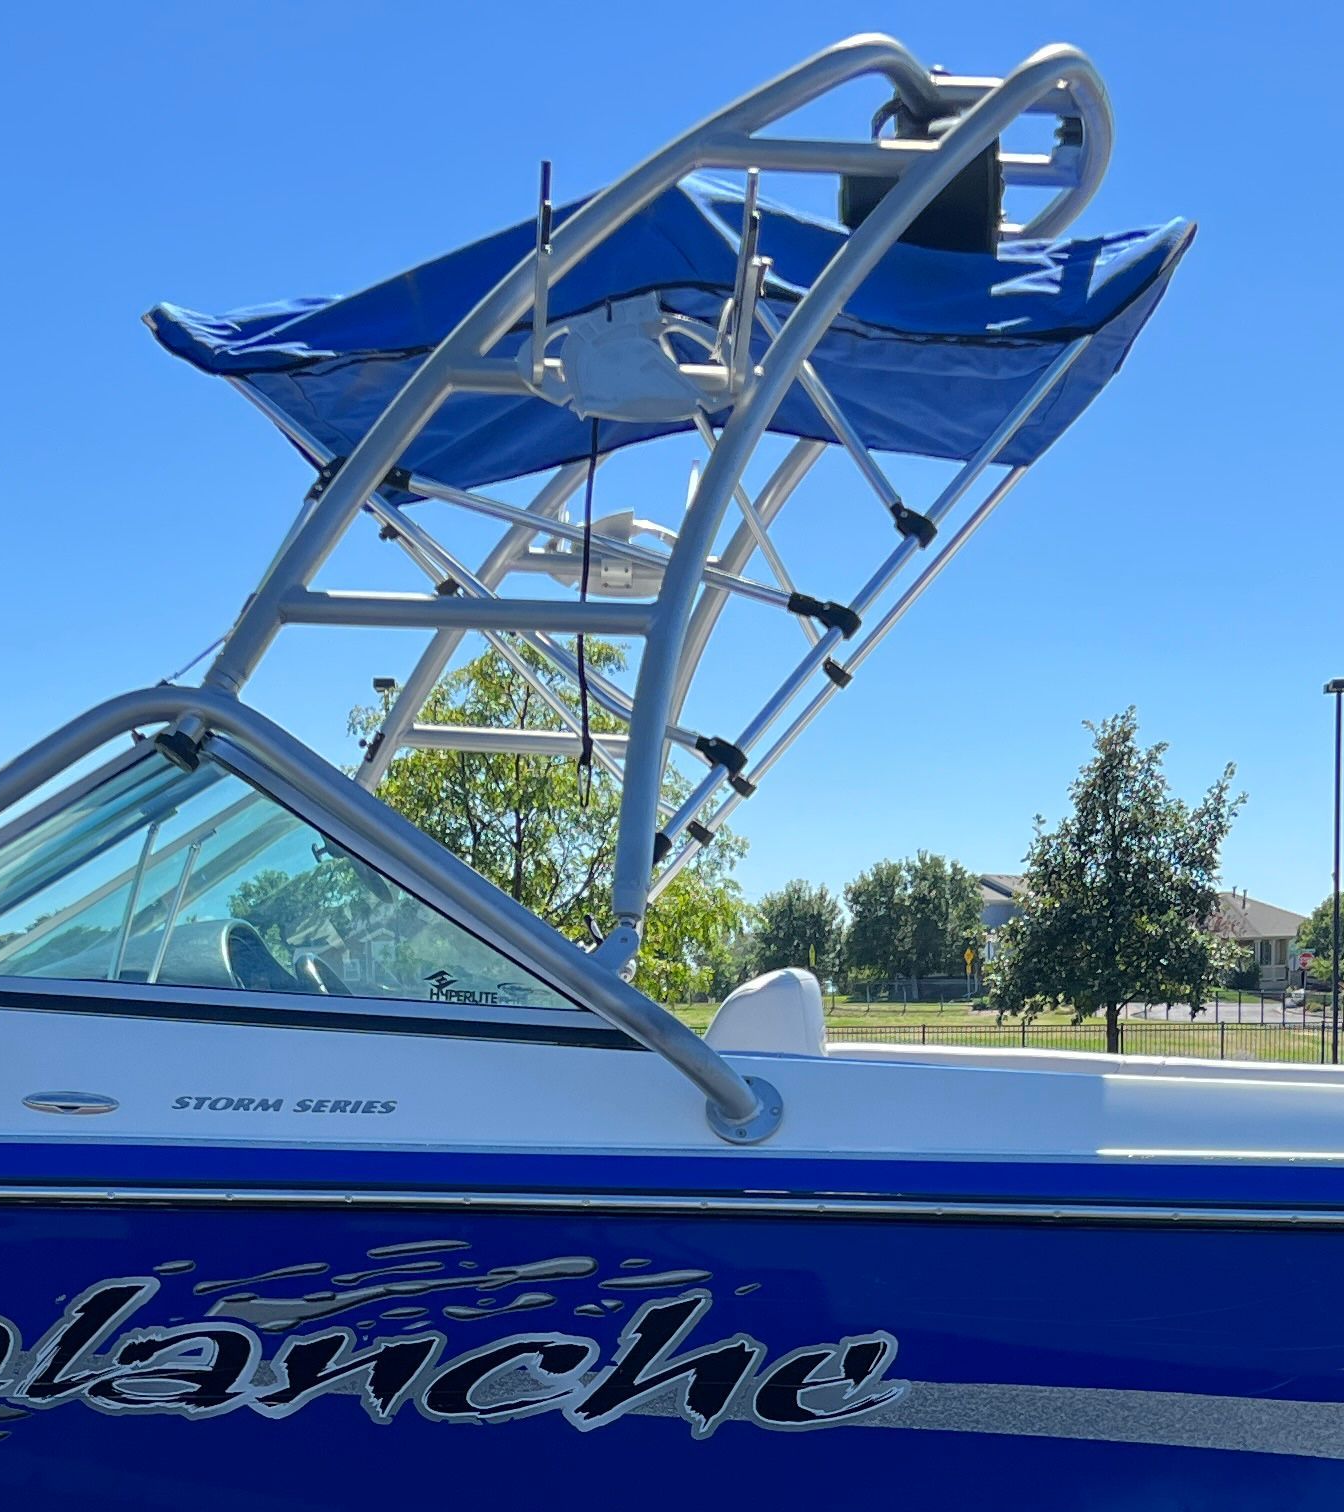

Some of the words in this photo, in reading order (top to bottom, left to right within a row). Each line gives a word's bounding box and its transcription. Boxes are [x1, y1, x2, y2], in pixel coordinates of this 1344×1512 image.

[430, 988, 498, 1005] HYPERLITE
[171, 1095, 282, 1113] STORM
[292, 1098, 398, 1115] SERIES
